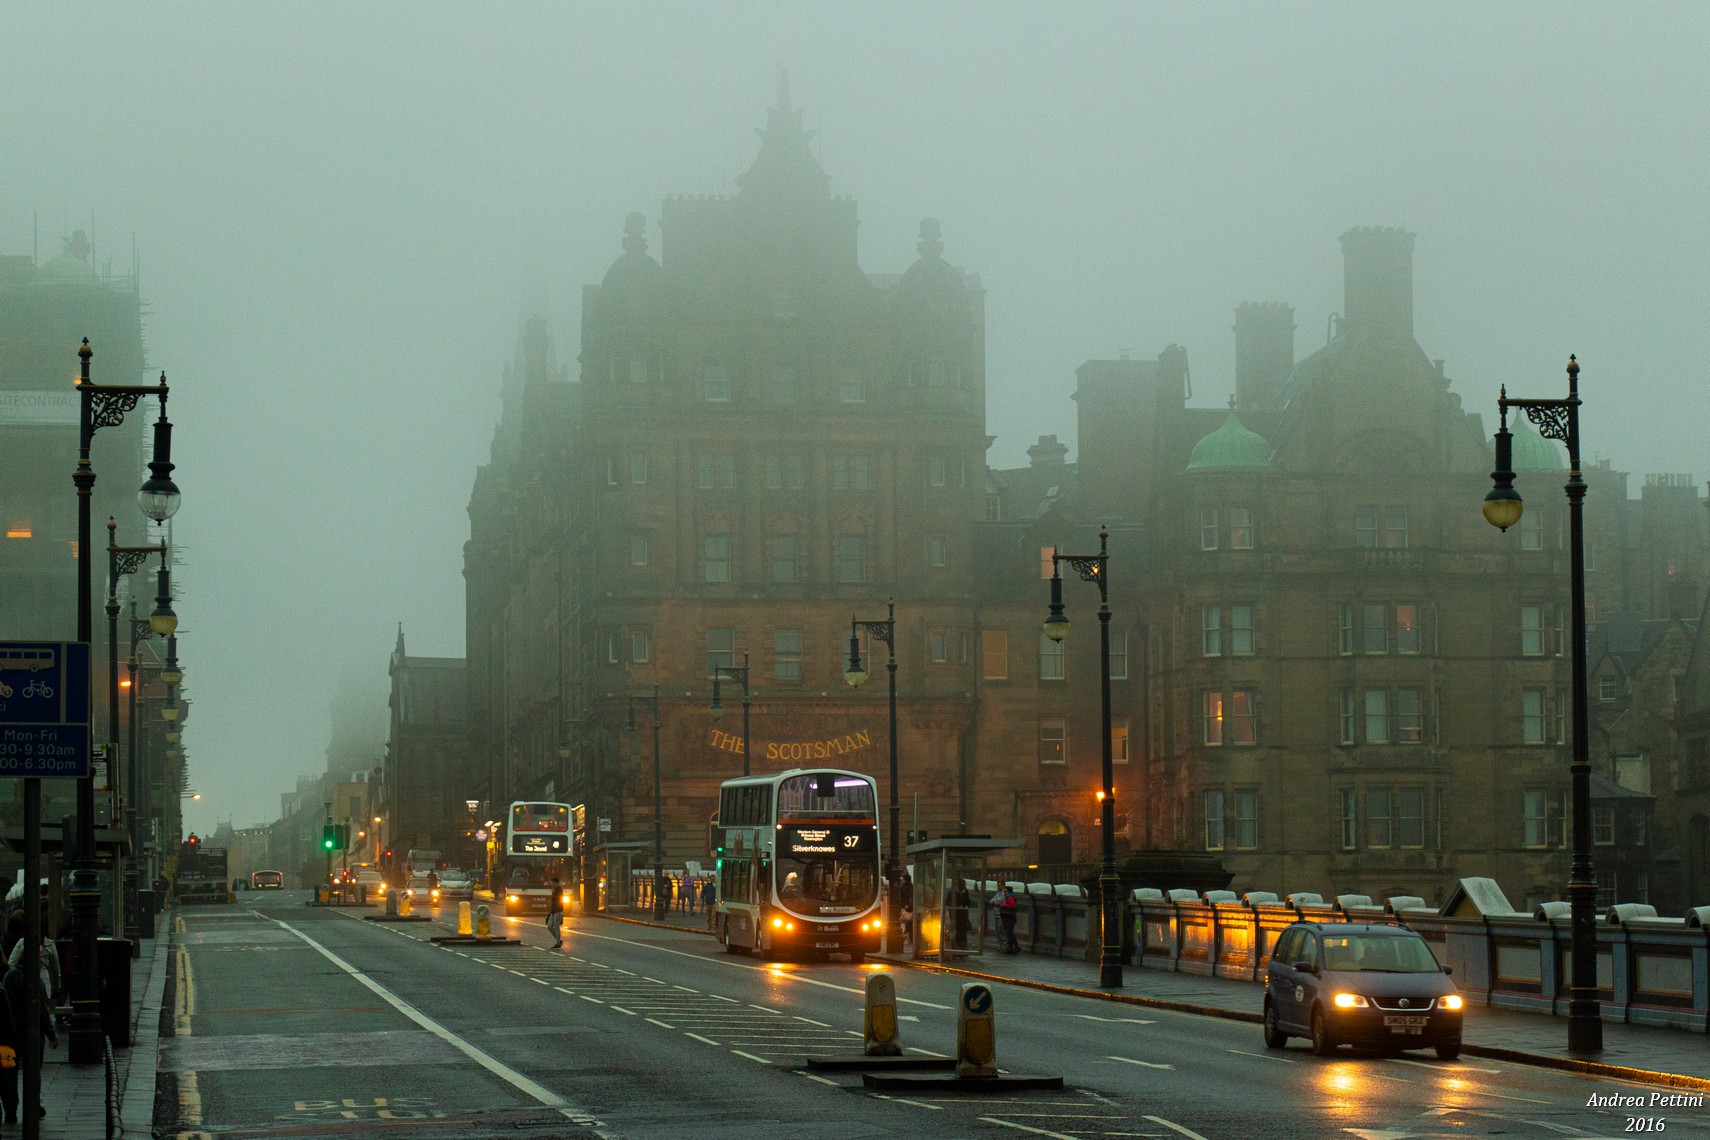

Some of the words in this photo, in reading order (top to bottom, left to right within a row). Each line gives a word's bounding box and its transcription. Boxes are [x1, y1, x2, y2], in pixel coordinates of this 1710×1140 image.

[711, 729, 745, 754] THE
[766, 729, 871, 760] SCOTSMAN
[844, 835, 859, 848] 37
